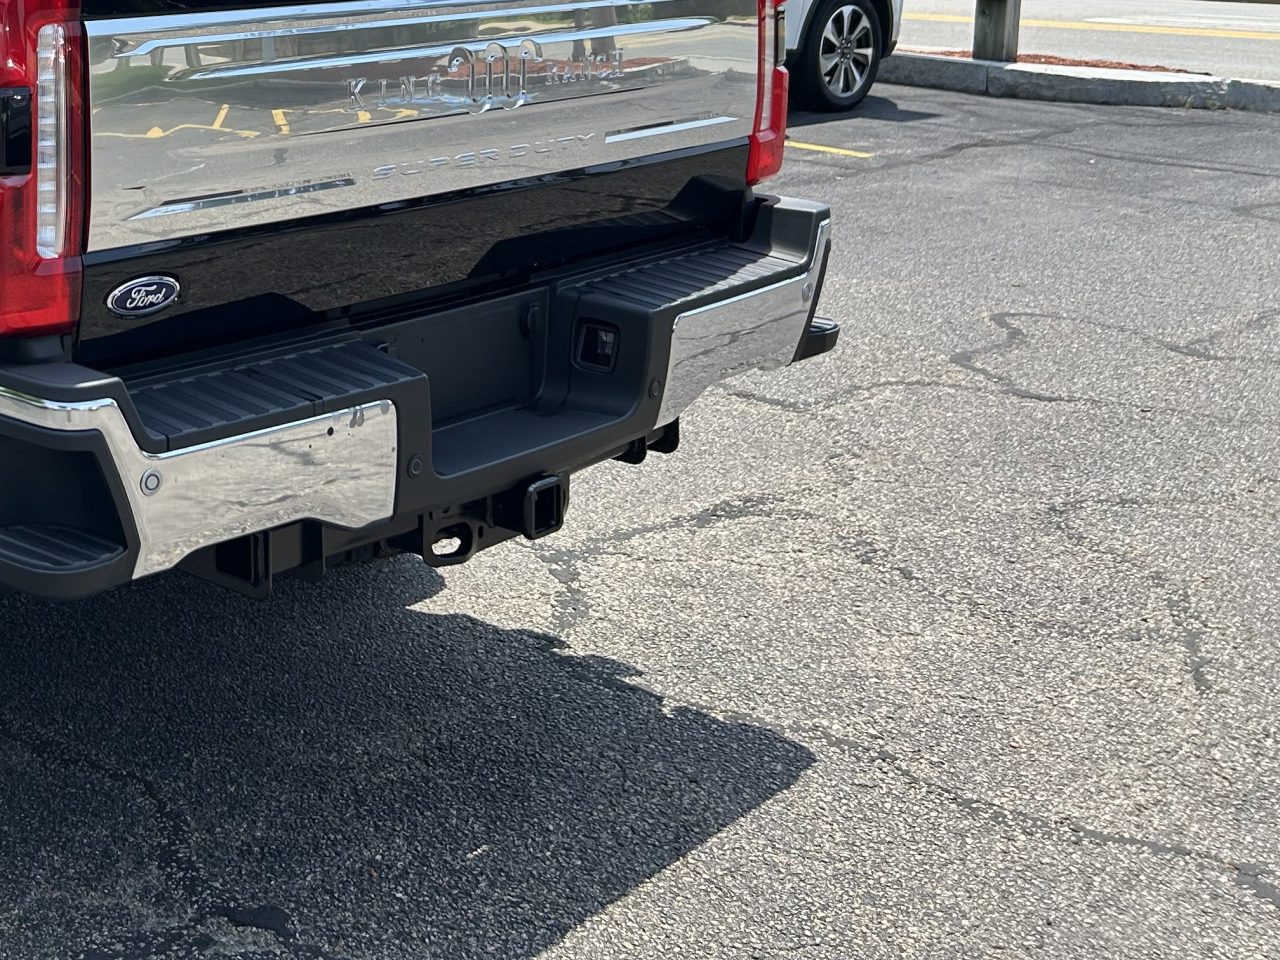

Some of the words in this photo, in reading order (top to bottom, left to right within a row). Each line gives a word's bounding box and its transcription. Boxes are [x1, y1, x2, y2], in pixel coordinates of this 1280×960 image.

[344, 72, 442, 112] KING
[545, 48, 626, 85] RANCH
[372, 148, 500, 180] SUPER
[509, 132, 596, 158] DUTY
[126, 284, 166, 308] Ford
